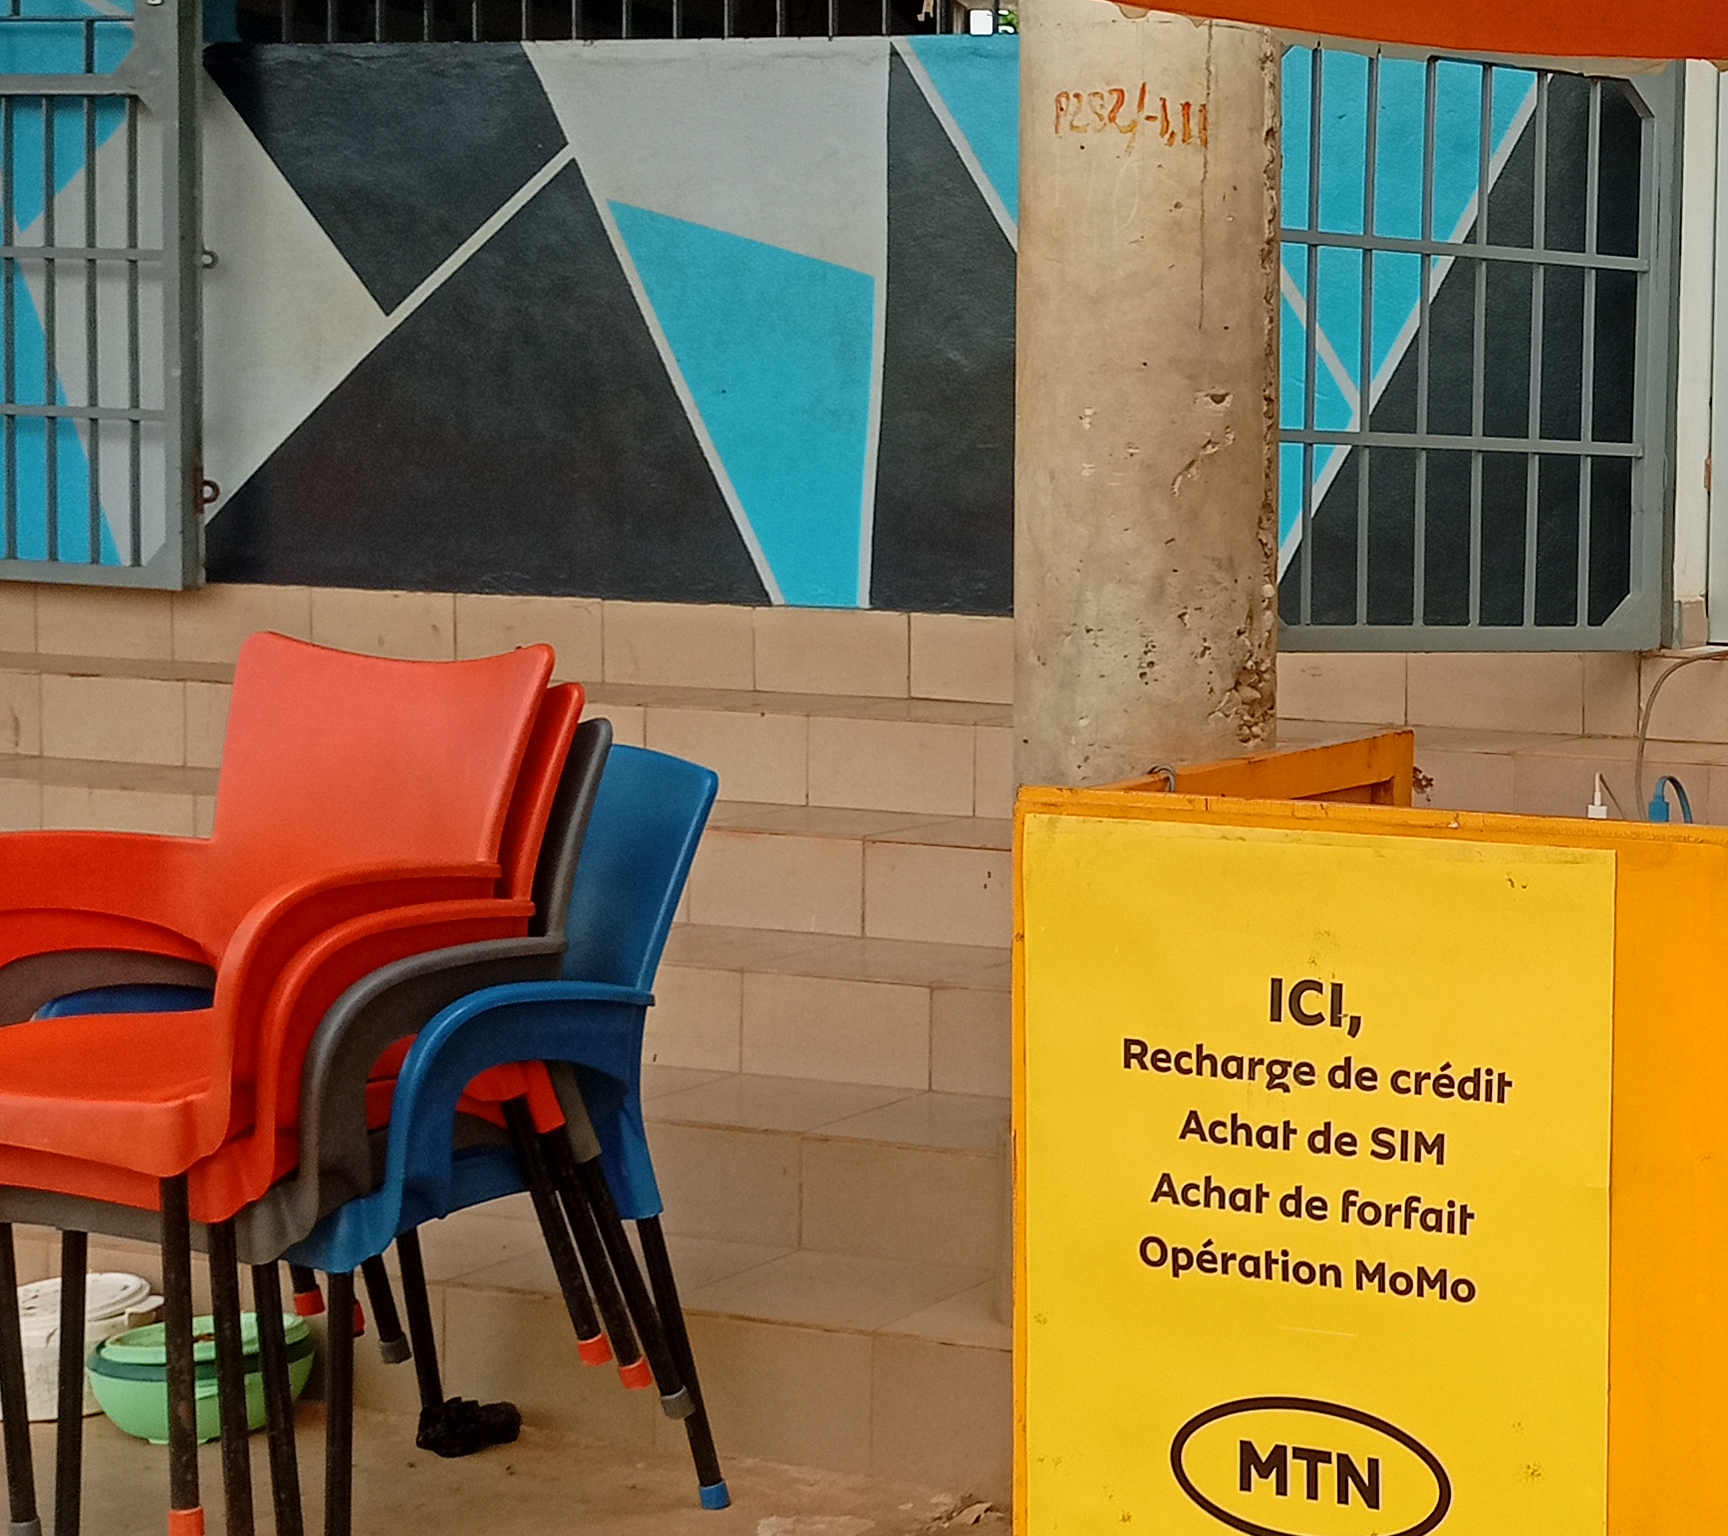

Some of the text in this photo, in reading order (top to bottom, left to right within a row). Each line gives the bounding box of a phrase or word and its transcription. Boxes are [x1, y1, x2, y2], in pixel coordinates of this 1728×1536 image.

[1268, 976, 1363, 1040] ICI,
[1122, 1036, 1514, 1105] Recharge de crédit
[1177, 1108, 1446, 1167] Achat de SIM
[1149, 1171, 1476, 1237] Achat de forfait
[1138, 1234, 1477, 1304] Opération MoMo
[1238, 1438, 1381, 1512] MTN
